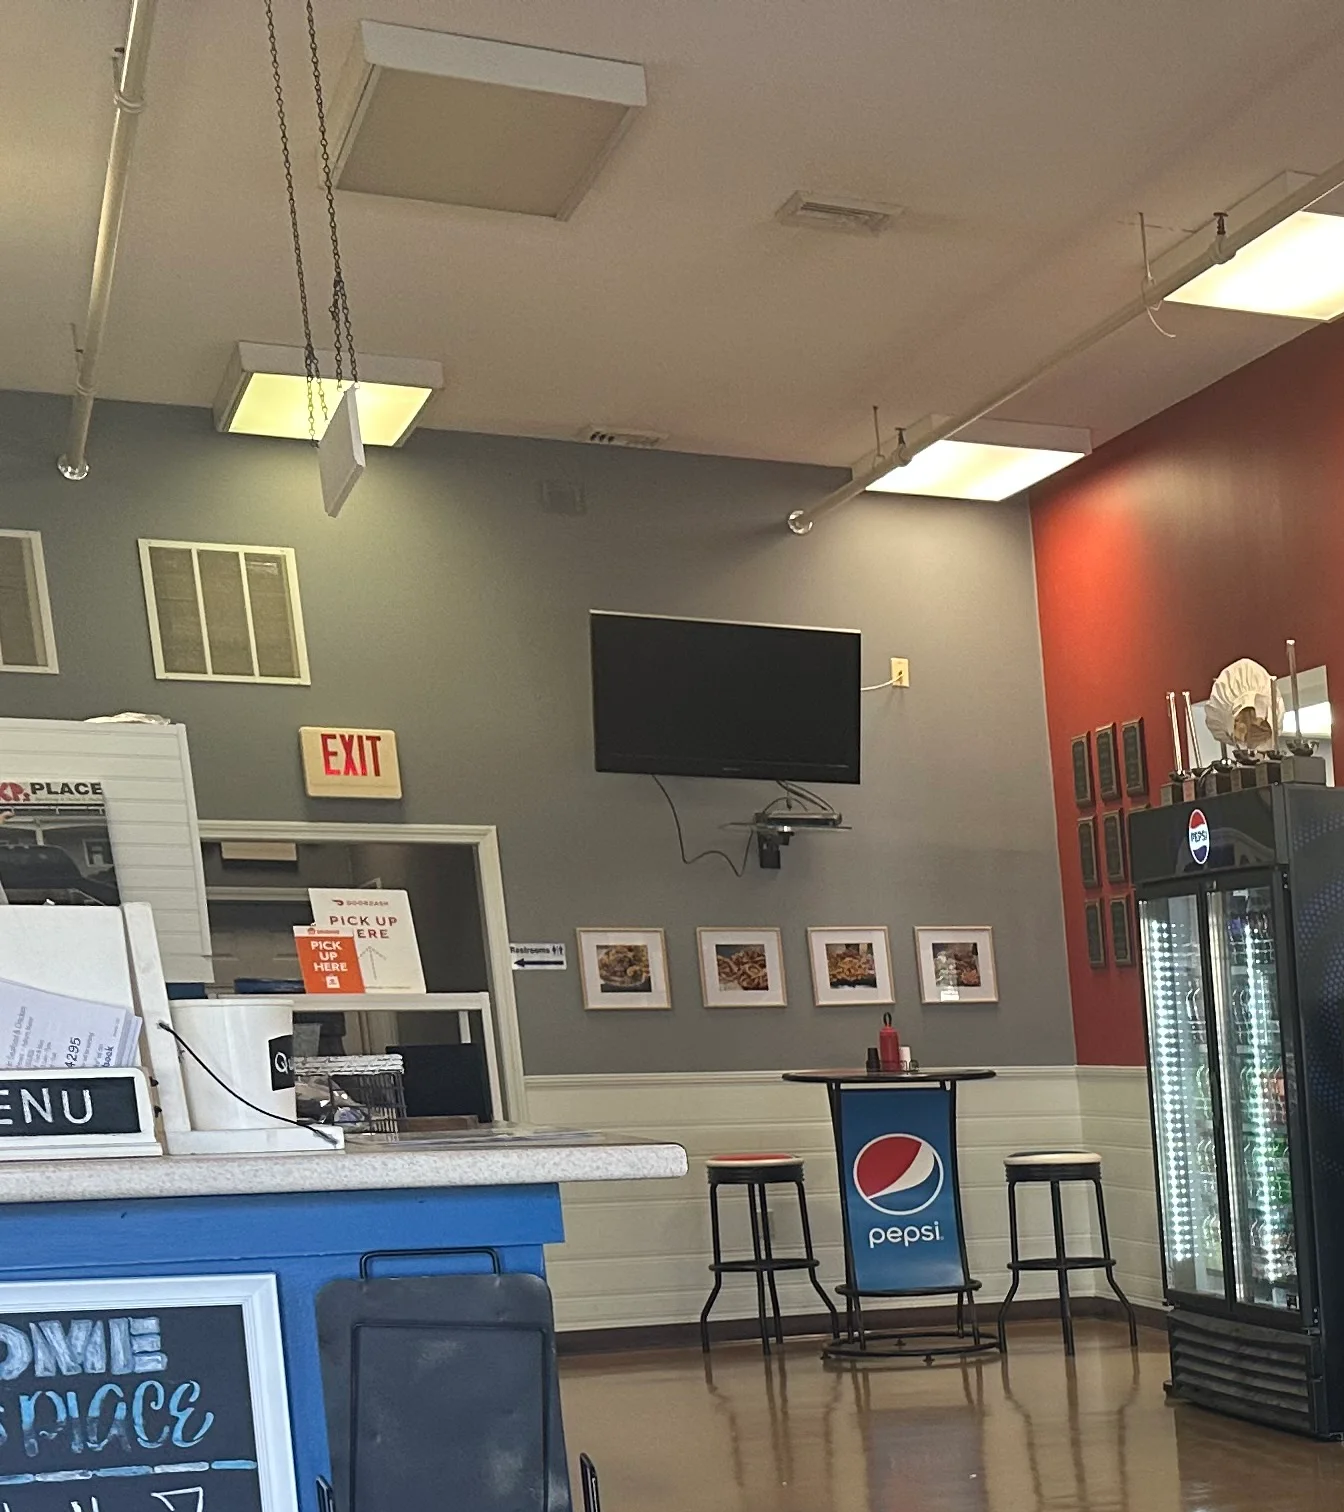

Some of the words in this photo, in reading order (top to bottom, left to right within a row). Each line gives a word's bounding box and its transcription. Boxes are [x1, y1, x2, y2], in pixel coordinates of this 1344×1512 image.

[321, 733, 381, 777] EXIT
[30, 782, 103, 796] PLACE
[329, 915, 371, 926] PICK
[376, 916, 398, 927] UP
[356, 928, 390, 939] ERE
[310, 940, 343, 951] PICK
[319, 951, 338, 961] UP
[313, 962, 349, 972] HERE
[868, 1220, 941, 1249] pepsi
